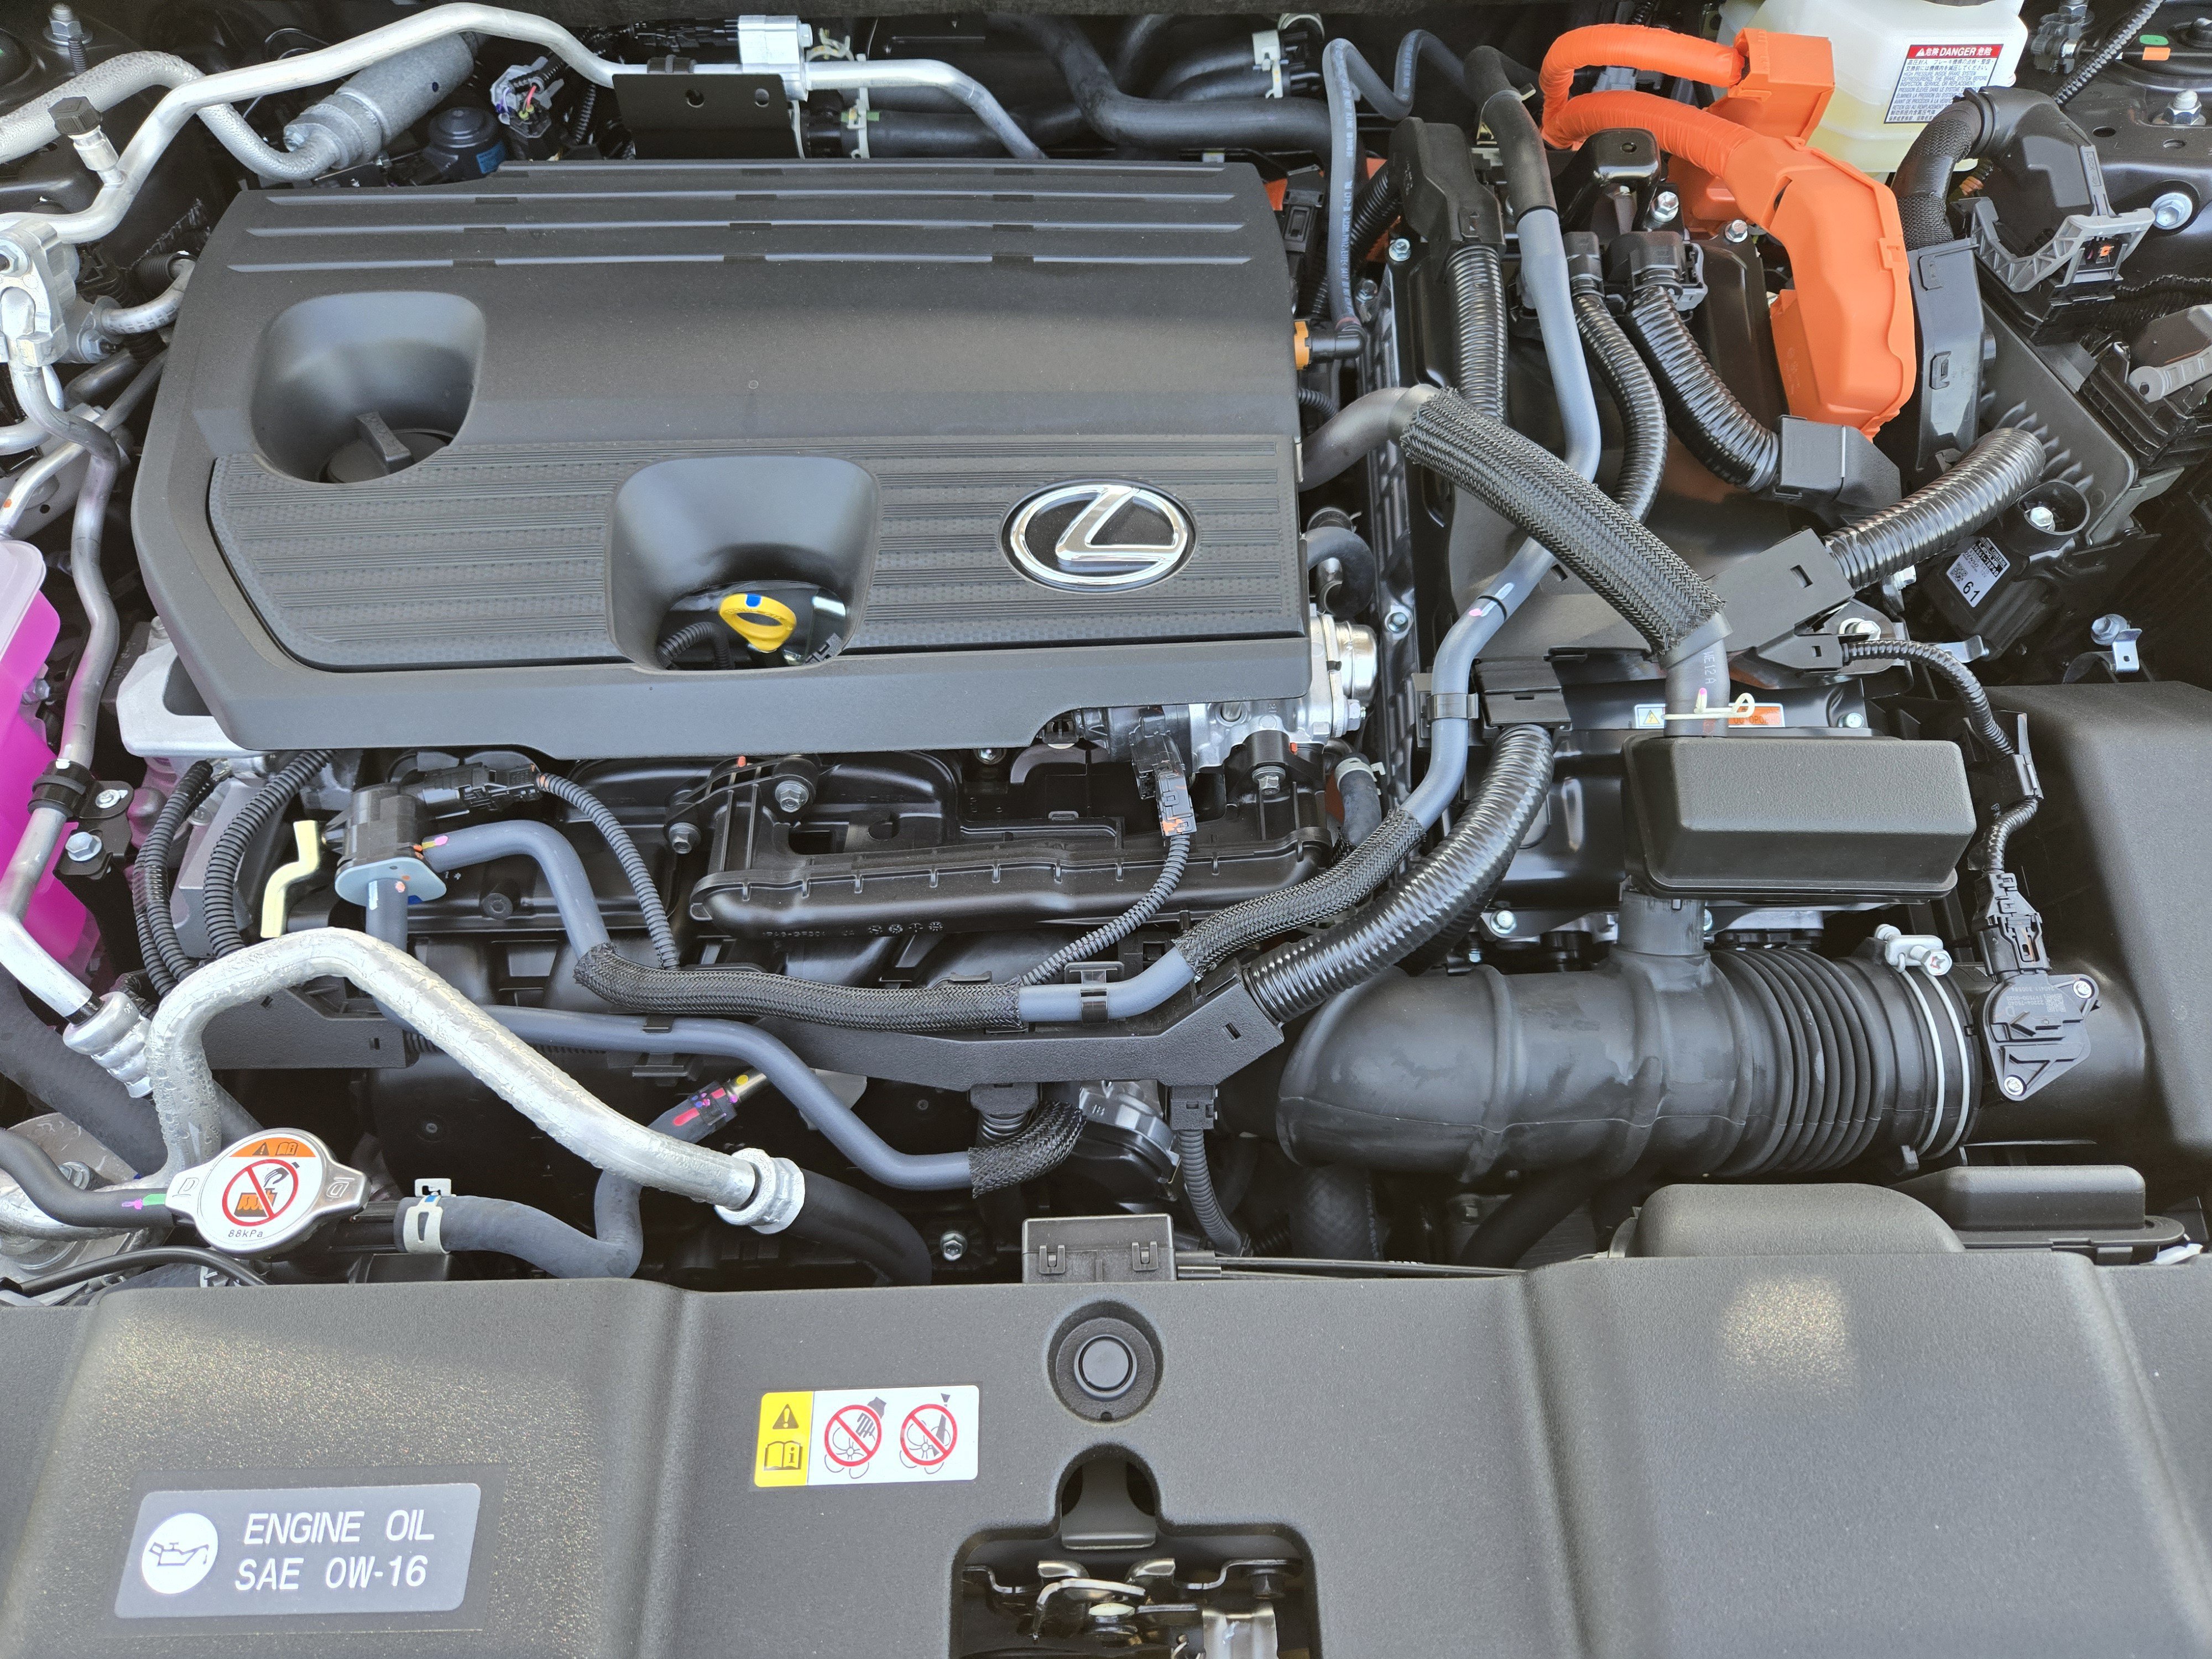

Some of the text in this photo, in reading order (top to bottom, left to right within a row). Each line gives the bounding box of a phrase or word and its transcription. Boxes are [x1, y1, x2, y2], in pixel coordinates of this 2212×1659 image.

[1940, 47, 1976, 56] DANGER
[2086, 153, 2095, 171] LOCK
[1965, 552, 1979, 568] DENSO
[1979, 542, 1999, 568] LEXUS
[1991, 549, 2007, 567] CONTROL
[1963, 581, 1980, 602] 61
[228, 1229, 263, 1238] 88kPa
[243, 1509, 435, 1545] ENGINE OIL
[235, 1555, 429, 1591] SAE 0W-16
